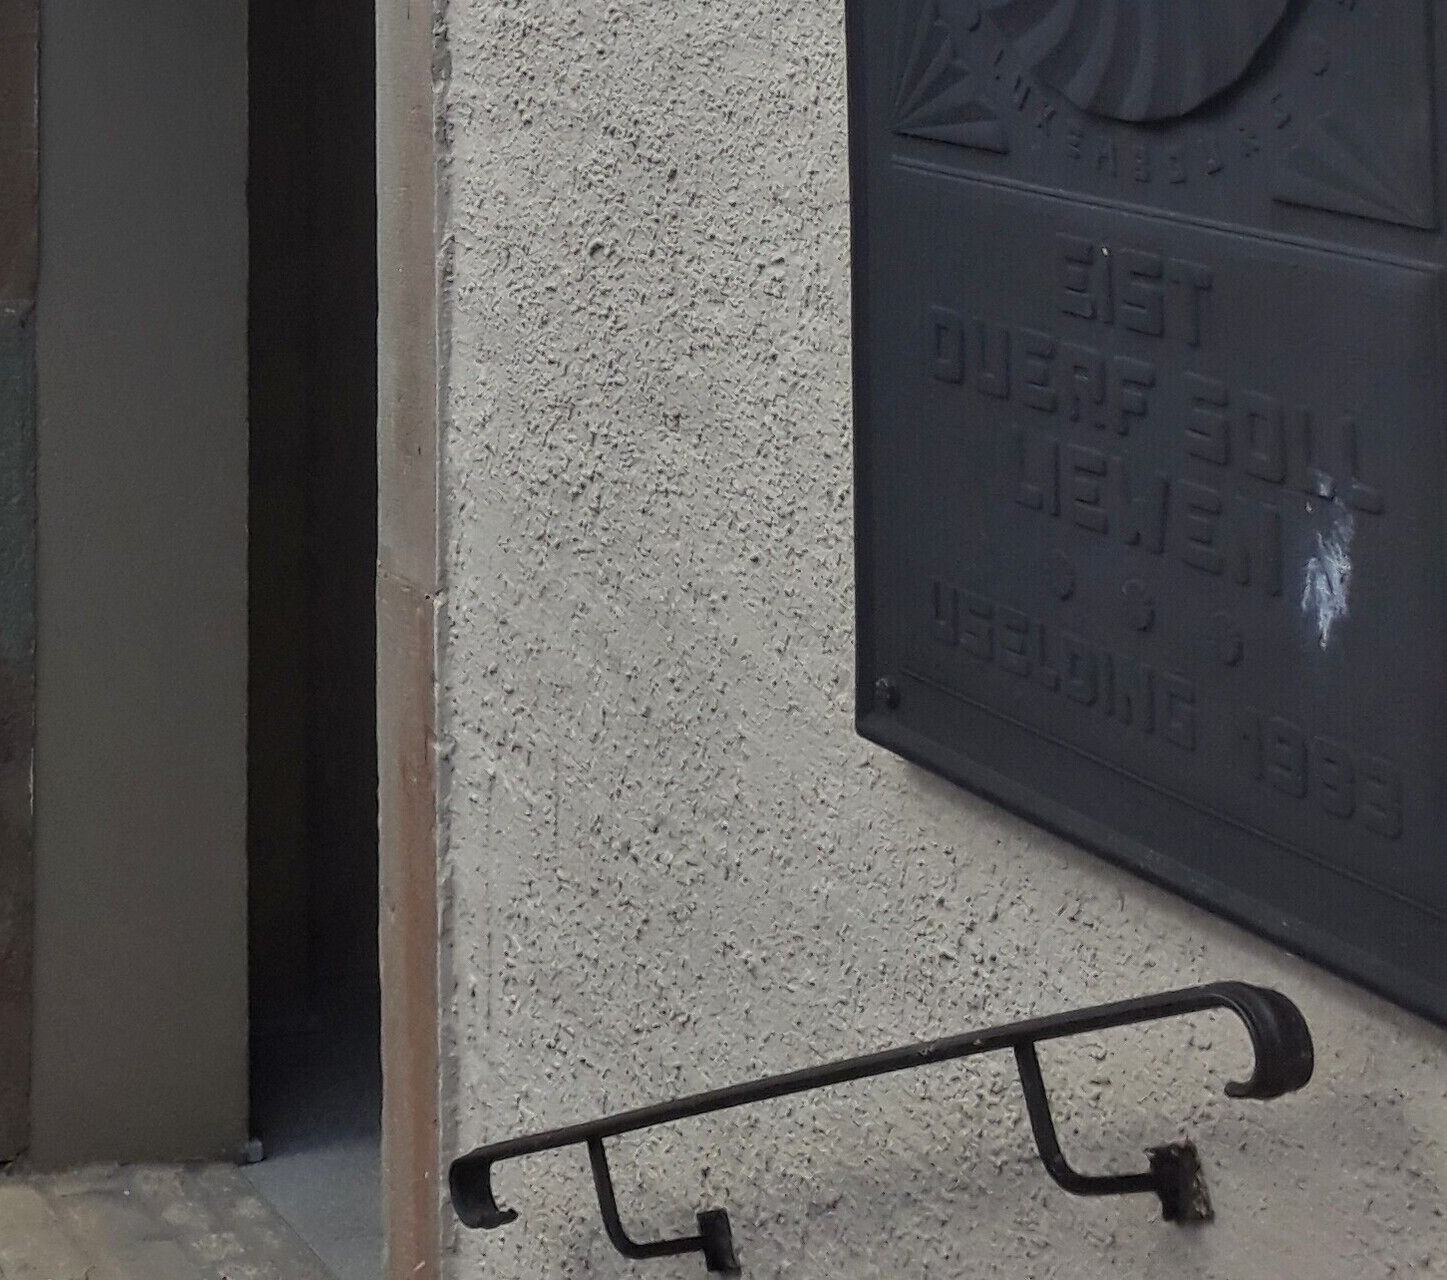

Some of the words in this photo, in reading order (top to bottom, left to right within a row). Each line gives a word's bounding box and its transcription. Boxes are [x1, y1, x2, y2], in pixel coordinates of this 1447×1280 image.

[1054, 231, 1215, 351] EIST
[930, 302, 1158, 438] DUERF
[1182, 369, 1387, 517] SOLL
[1009, 422, 1285, 600] LIEWEN
[929, 574, 1198, 753] USELDING
